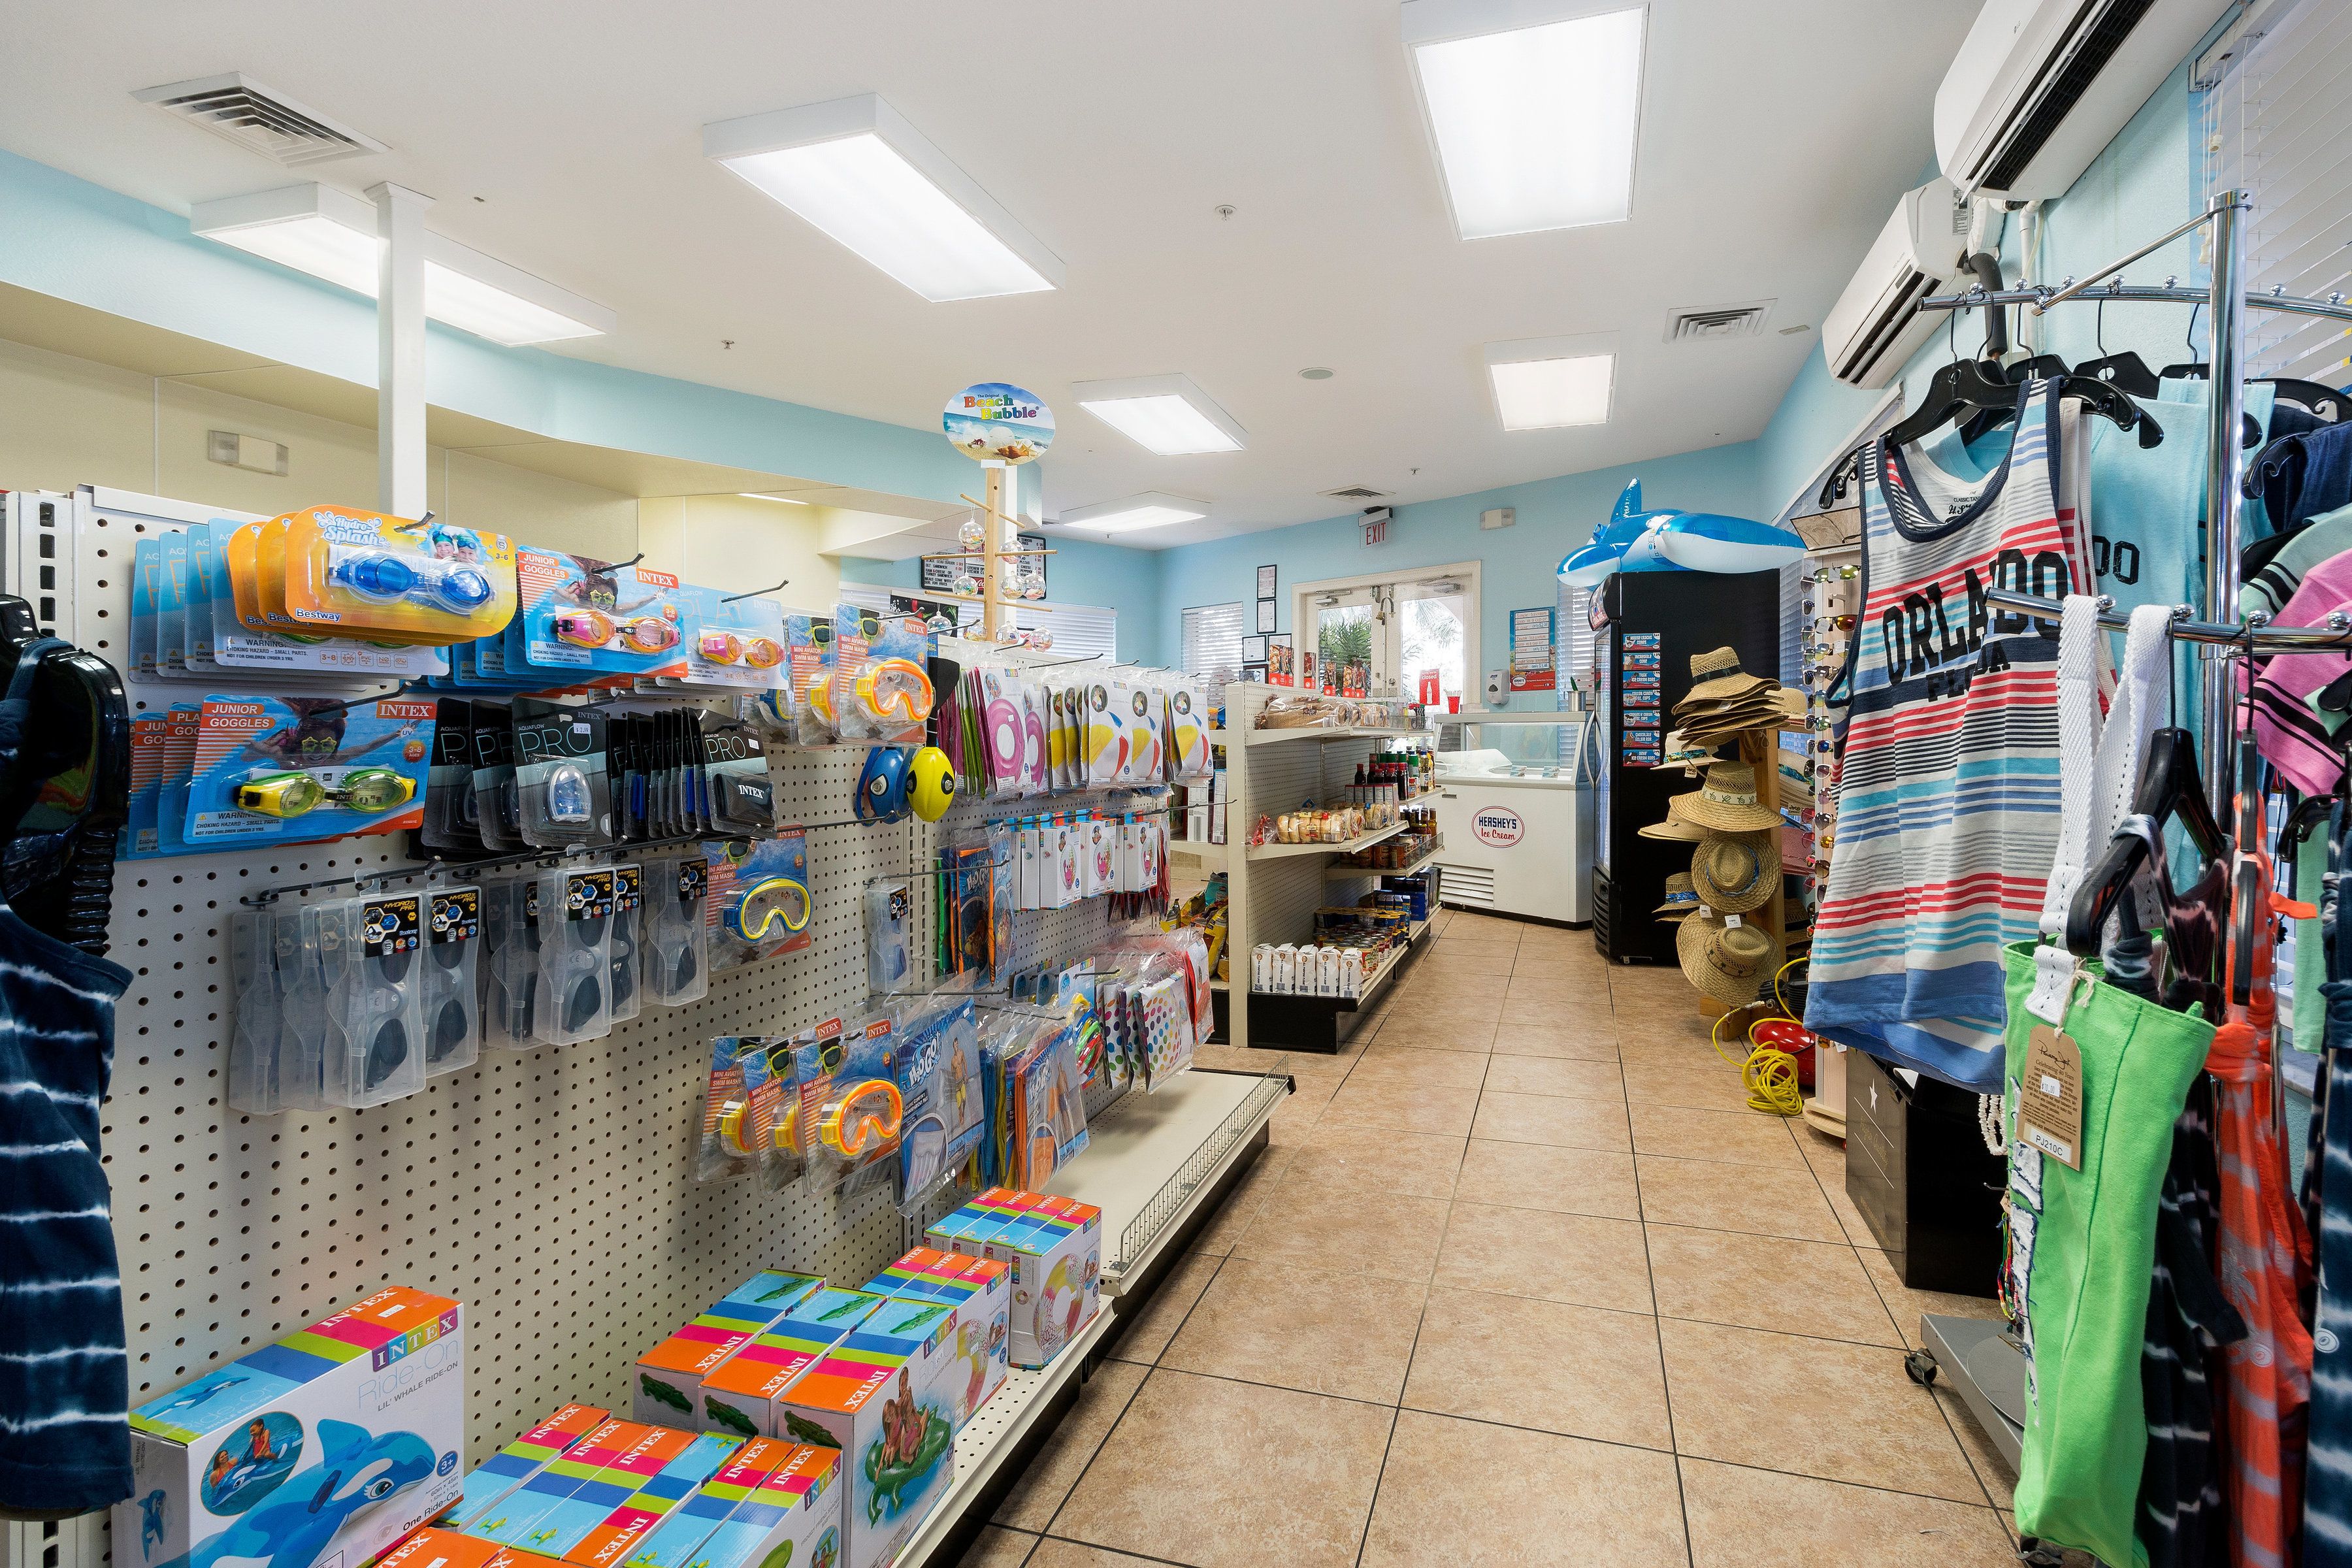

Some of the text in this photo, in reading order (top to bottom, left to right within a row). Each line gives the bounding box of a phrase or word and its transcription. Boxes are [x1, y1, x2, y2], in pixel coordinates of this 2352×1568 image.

[964, 395, 1014, 408] Beach
[981, 406, 1037, 420] Bubble
[334, 515, 372, 531] Hydro-
[324, 527, 380, 547] Splash
[1366, 522, 1386, 546] EXIT
[523, 554, 555, 566] JUNIOR
[524, 565, 566, 578] GOGGLES
[639, 571, 673, 585] INTEX
[753, 600, 779, 612] INTEX
[295, 608, 341, 622] Bestway
[1883, 548, 2068, 686] ORLADO
[906, 623, 924, 634] INTEX
[851, 637, 869, 646] AVIATOR
[212, 704, 258, 714] JUNIOR
[380, 704, 430, 717] INTEX
[578, 711, 601, 720] INTEX
[210, 717, 270, 728] GOGGLES
[743, 725, 759, 736] INTEX
[519, 724, 592, 762] PRO
[706, 736, 746, 762] PRO
[738, 785, 764, 799] INTEX
[1478, 816, 1517, 830] HERSHEY'S
[1481, 827, 1516, 840] Ice Cream
[817, 1023, 839, 1035] INTEX
[868, 1026, 888, 1037] INTEX
[2036, 1060, 2058, 1075] Celebrating
[762, 1078, 782, 1091] AVIATOR
[814, 1075, 832, 1086] AVIATOR
[754, 1088, 780, 1104] SWIM MASK
[817, 1085, 830, 1094] MASK
[2036, 1135, 2063, 1156] PJ210C
[980, 1188, 1000, 1201] INTEX
[1007, 1190, 1028, 1205] INTEX
[1037, 1195, 1058, 1209] INTEX
[1062, 1203, 1082, 1218] INTEX
[899, 1247, 924, 1265] INTEX
[932, 1253, 956, 1270] INTEX
[964, 1258, 988, 1276] INTEX
[987, 1270, 1009, 1294] INTEX
[318, 1287, 398, 1328] INTEX
[378, 1315, 453, 1367] INTEX
[924, 1315, 956, 1356] INTEX
[695, 1335, 745, 1371] INTEX
[358, 1340, 458, 1409] Ride-On
[760, 1357, 810, 1395] INTEX
[378, 1361, 458, 1411] LIL' WHALE RIDE-ON
[844, 1370, 889, 1410] INTEX
[531, 1406, 581, 1439] INTEX
[572, 1422, 622, 1457] INTEX
[619, 1429, 668, 1465] INTEX
[441, 1460, 453, 1470] 3+
[725, 1442, 770, 1478] INTEX
[773, 1449, 815, 1486] INTEX
[431, 1486, 442, 1496] 60in
[448, 1476, 459, 1484] 45in
[806, 1460, 840, 1509] INTEX
[403, 1490, 459, 1531] One Ride-On
[801, 1514, 827, 1546] FROGGY FRIEND
[593, 1516, 650, 1563] INTEX
